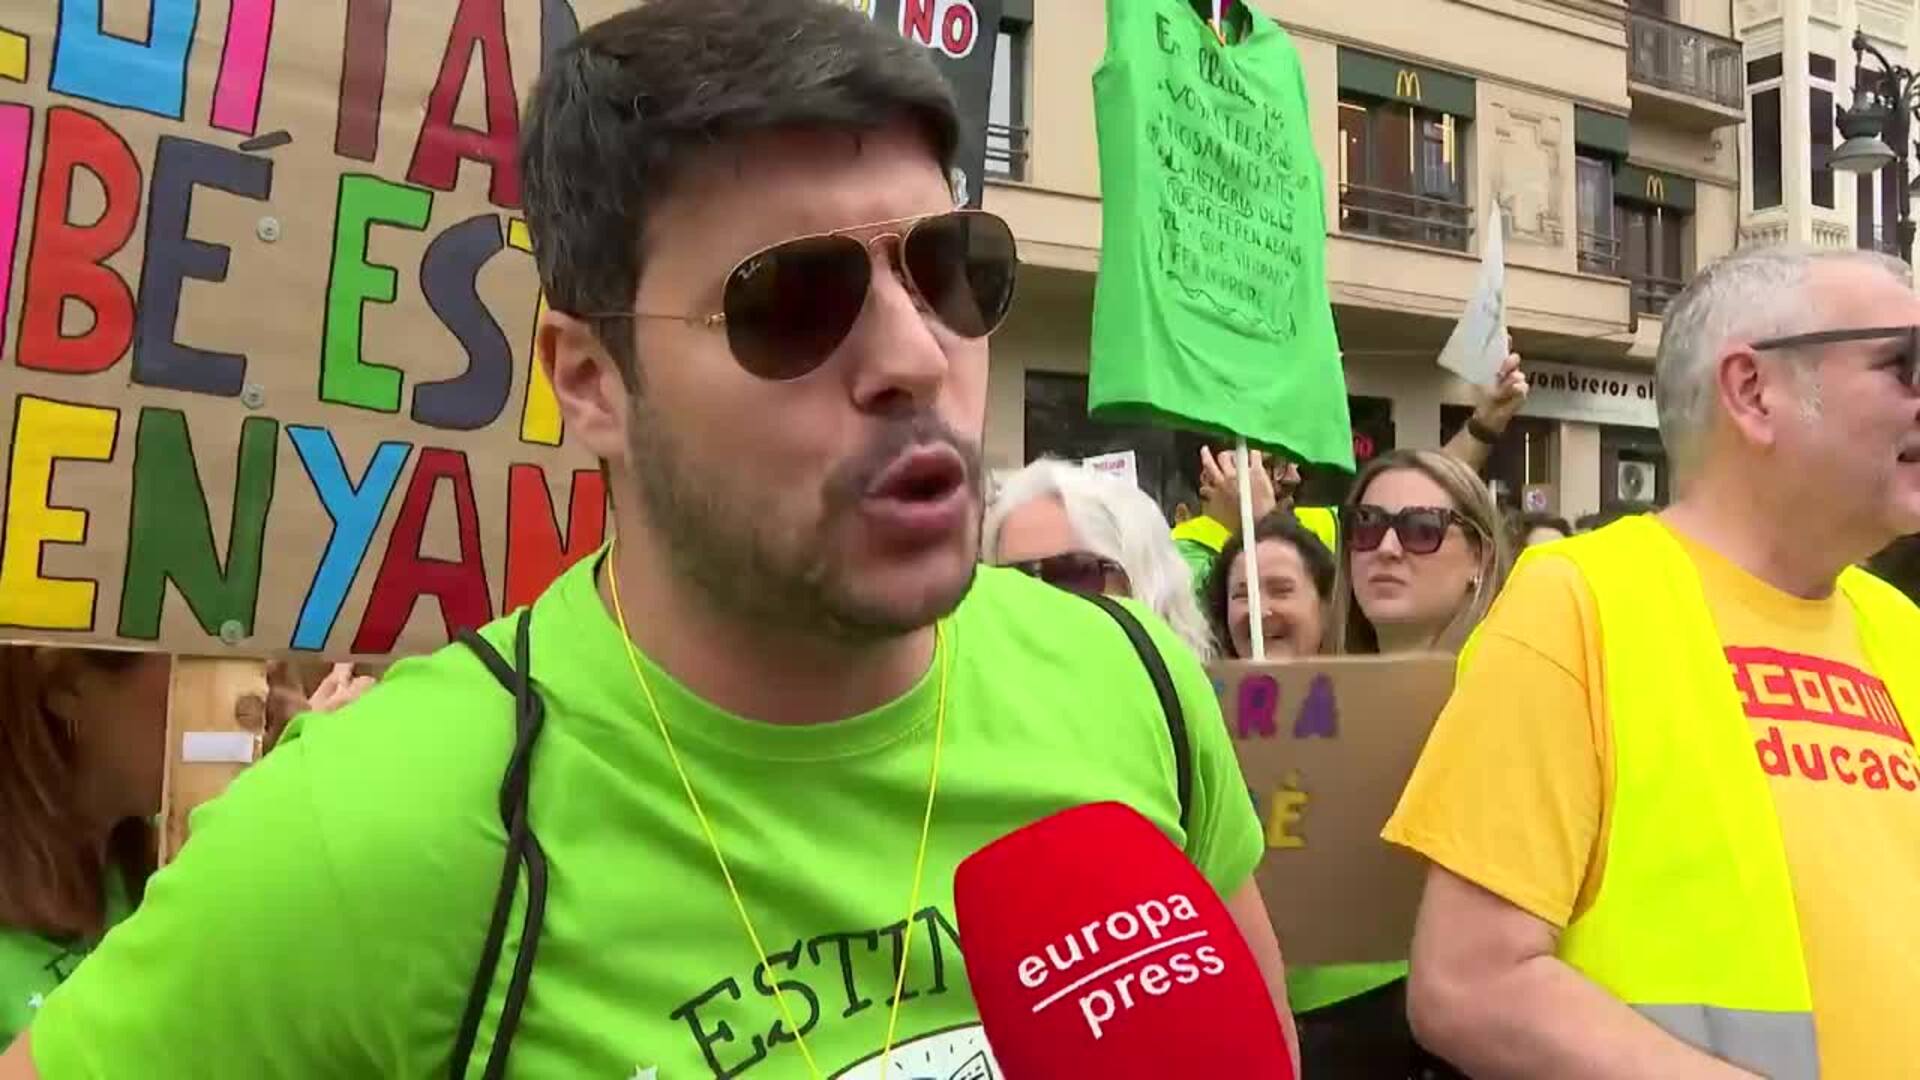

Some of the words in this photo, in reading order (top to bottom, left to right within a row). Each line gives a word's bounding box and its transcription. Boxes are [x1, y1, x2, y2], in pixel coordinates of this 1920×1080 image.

[901, 0, 976, 56] NO
[0, 104, 291, 398] BÉ
[1526, 370, 1628, 397] sombreros
[1214, 671, 1340, 740] RA
[1250, 768, 1310, 848] É
[1017, 893, 1200, 989] europa
[1078, 940, 1225, 1039] press
